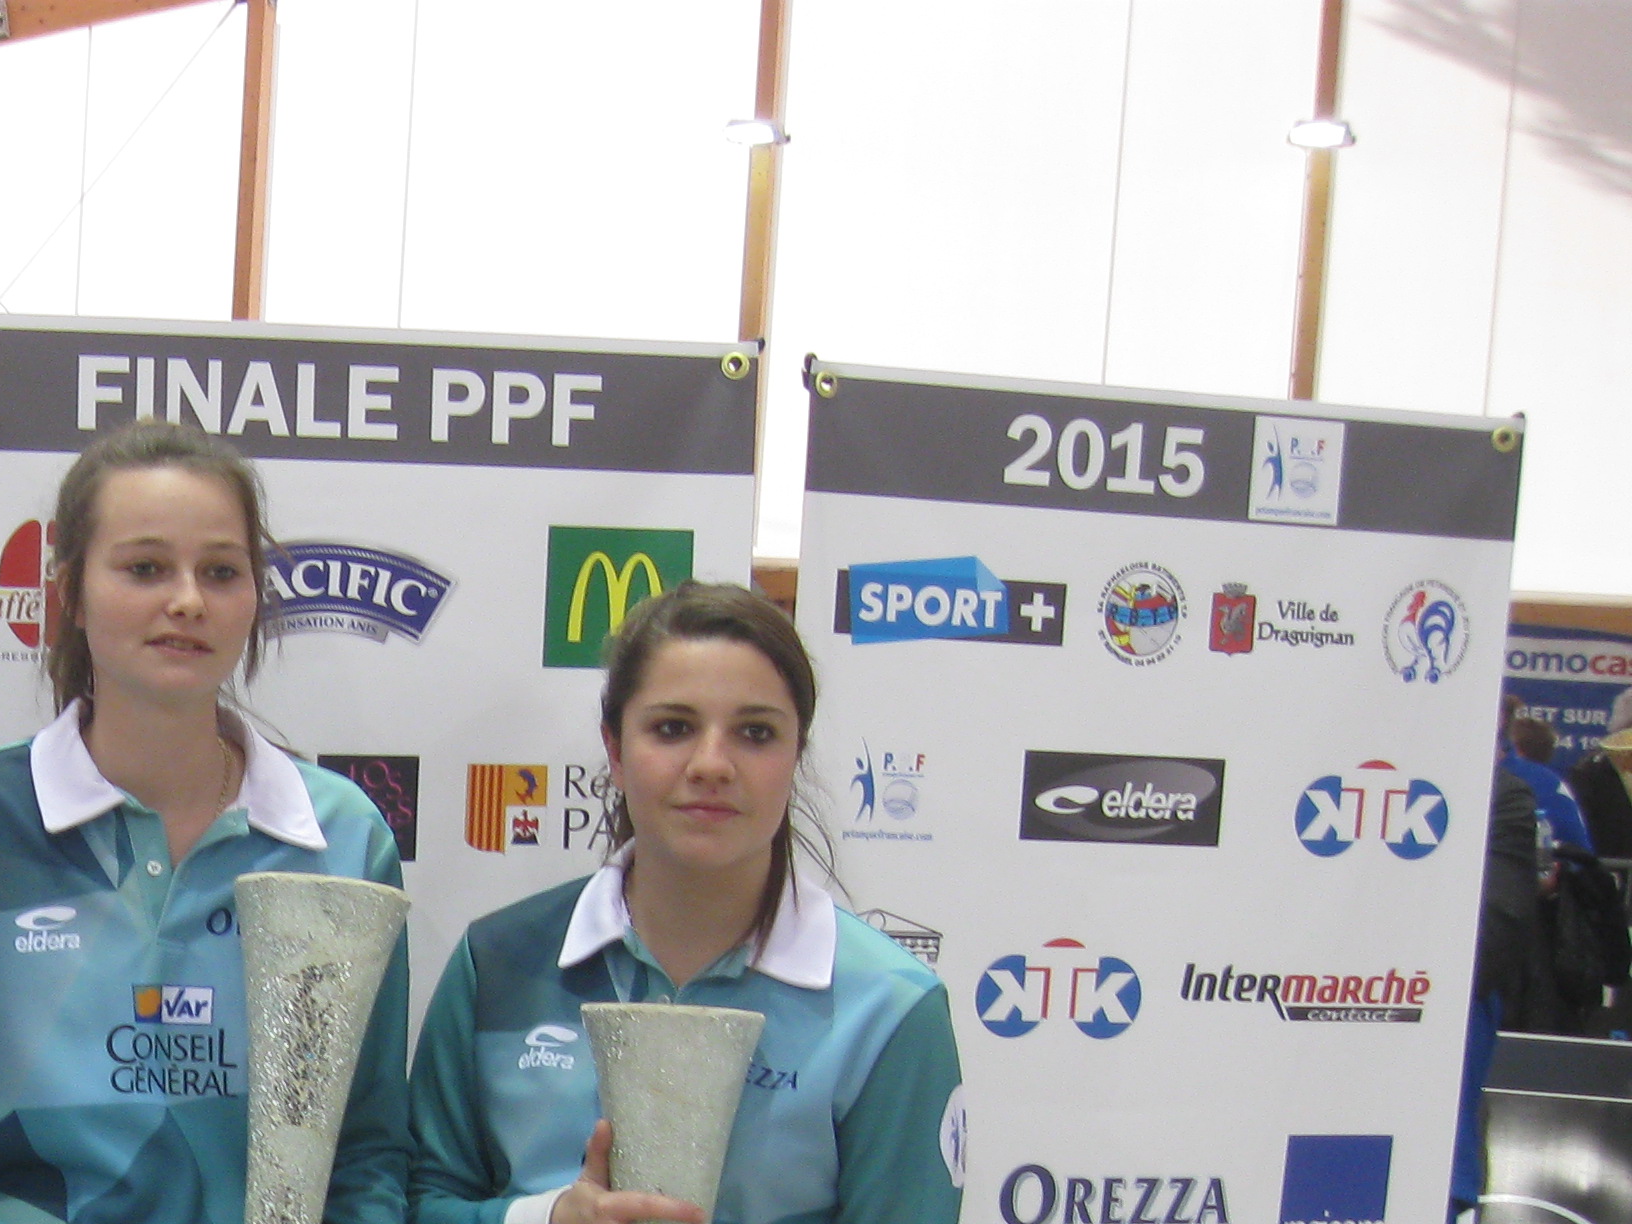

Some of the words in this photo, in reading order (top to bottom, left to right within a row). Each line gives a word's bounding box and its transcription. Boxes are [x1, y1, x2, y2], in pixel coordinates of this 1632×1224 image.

[77, 354, 400, 440] FINALE
[431, 367, 603, 448] PPF
[1003, 414, 1205, 498] 2015
[266, 559, 428, 617] ACIFIC
[858, 582, 1003, 629] SPORT
[1277, 599, 1314, 623] Ville
[1318, 602, 1339, 623] de
[1258, 623, 1355, 649] Draguignan
[1101, 782, 1197, 822] eldera
[14, 929, 81, 954] eldera
